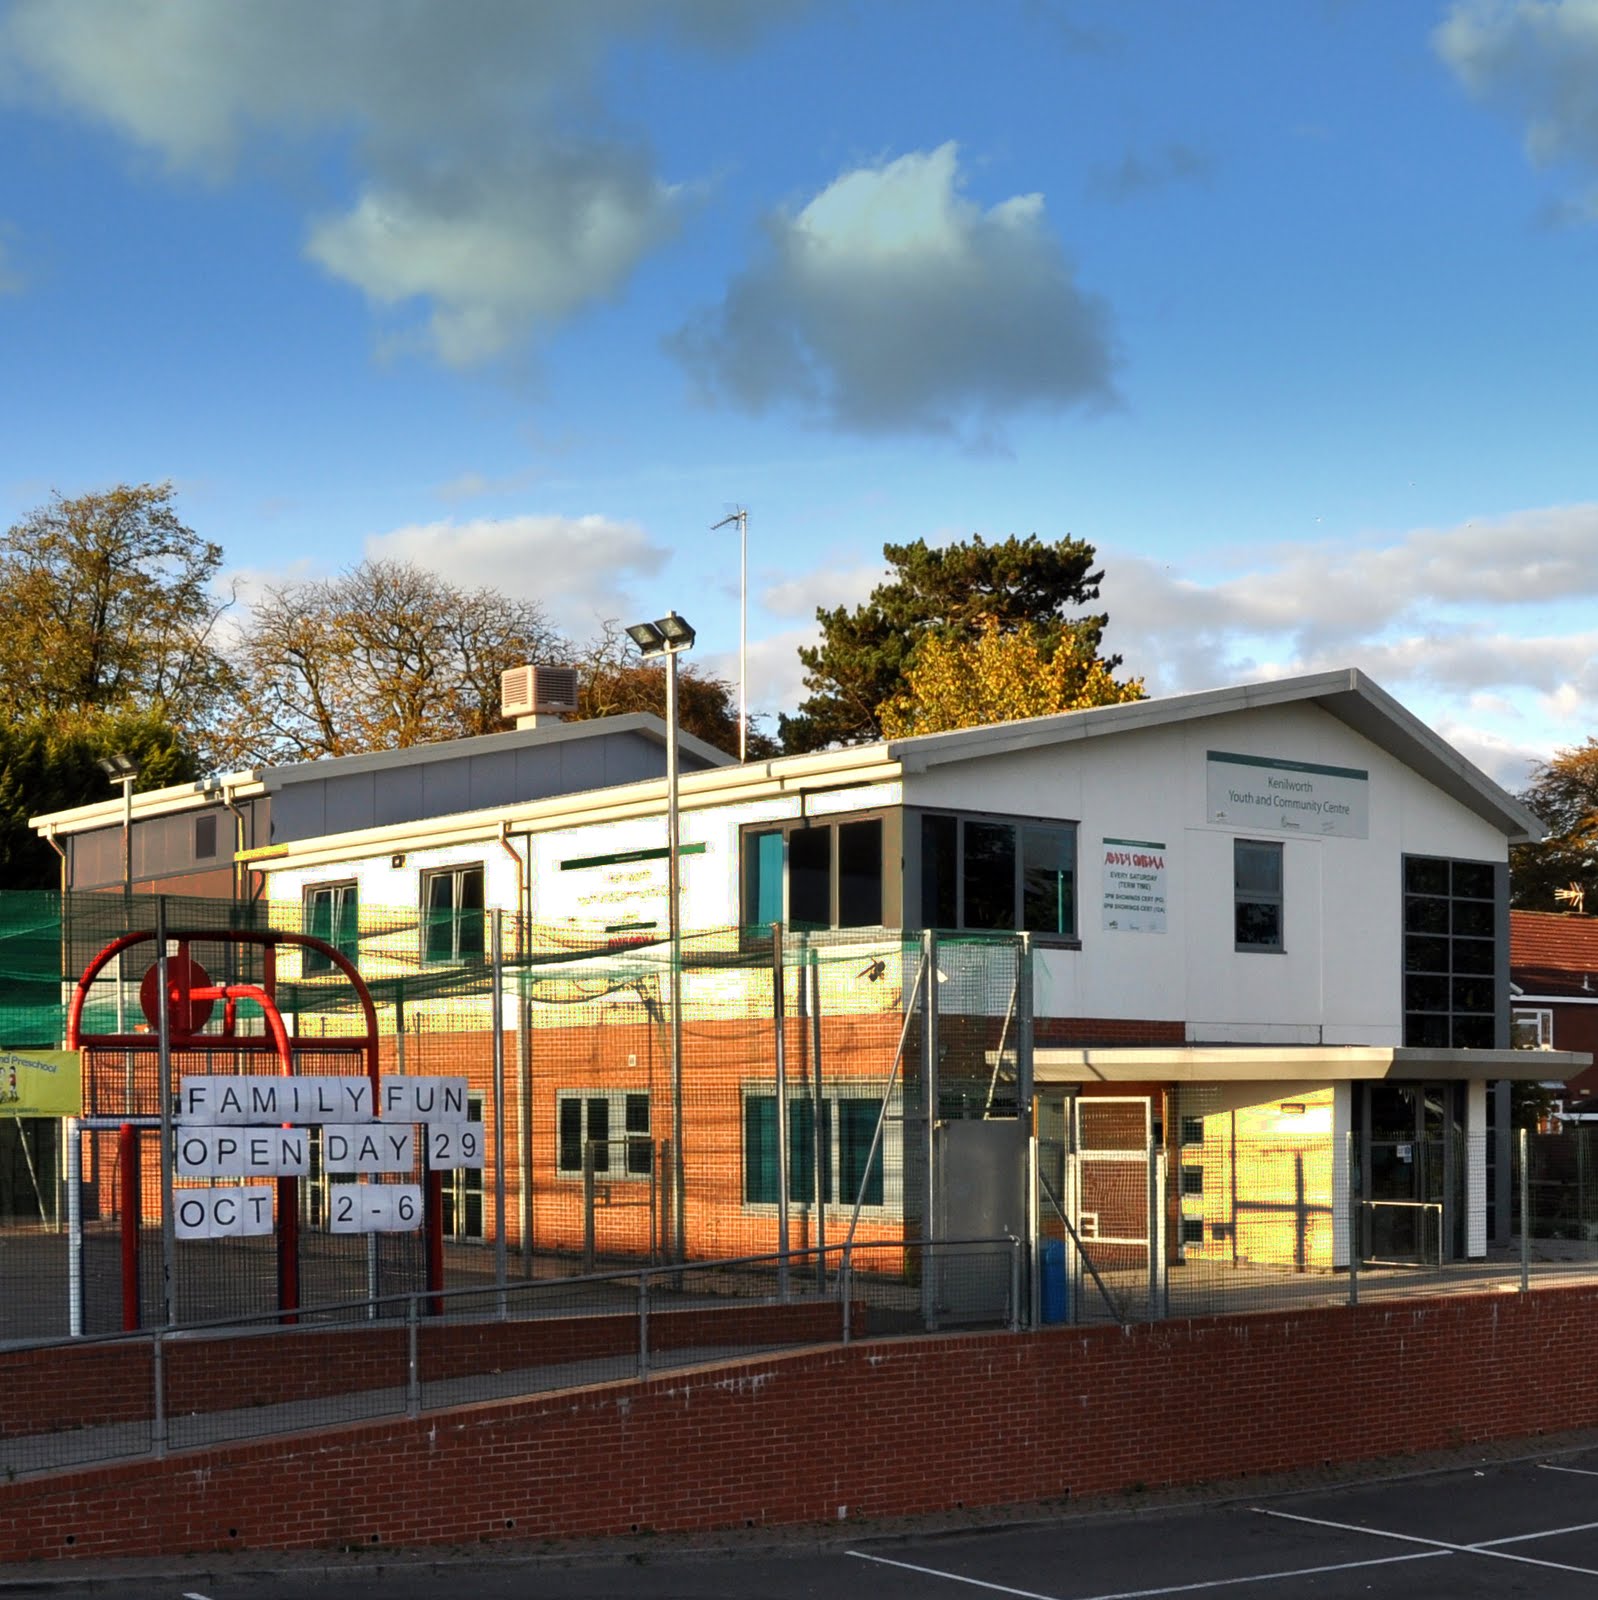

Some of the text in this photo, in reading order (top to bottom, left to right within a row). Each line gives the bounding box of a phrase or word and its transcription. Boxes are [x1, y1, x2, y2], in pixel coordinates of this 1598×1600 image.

[1267, 776, 1313, 793] Kenilworth
[1228, 790, 1350, 815] Youth and Community Centre
[1110, 871, 1157, 882] EVERY SATURDAY
[12, 1056, 57, 1073] Preschool
[188, 1086, 462, 1114] FAMILY FUN
[182, 1132, 476, 1166] OPEN DAY 29
[180, 1197, 267, 1228] OCT
